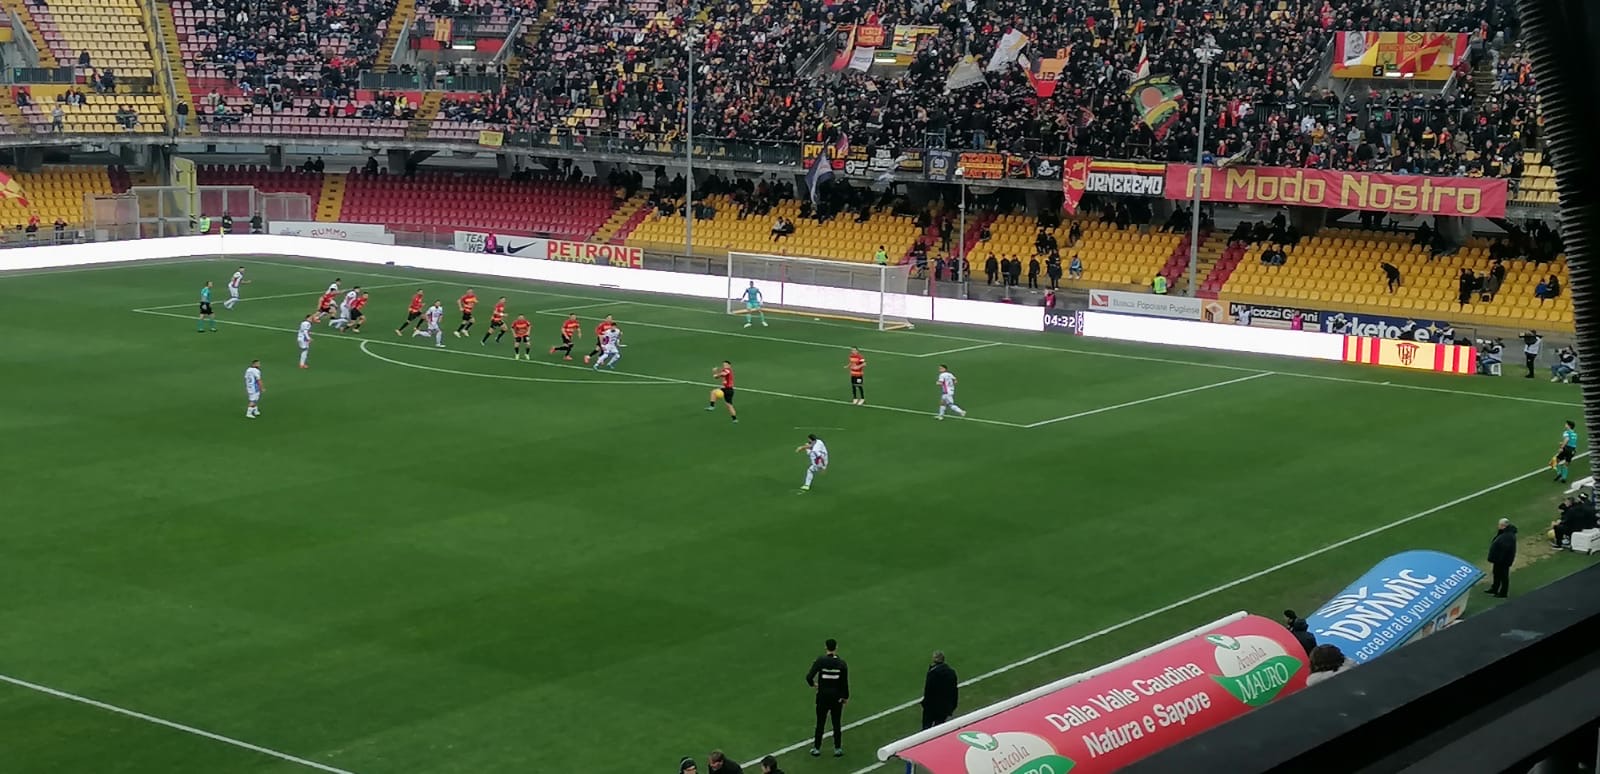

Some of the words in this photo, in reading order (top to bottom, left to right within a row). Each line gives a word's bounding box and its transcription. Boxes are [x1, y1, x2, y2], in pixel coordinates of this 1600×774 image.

[1374, 67, 1382, 76] 5
[1085, 173, 1163, 195] ORNEREMO
[1186, 168, 1211, 198] A
[1225, 169, 1326, 204] Modo
[1341, 174, 1482, 214] Nostro
[311, 228, 347, 238] RUMMO
[466, 233, 483, 243] TEA
[547, 240, 642, 269] PETRONE
[1044, 314, 1075, 328] 04:32
[1282, 309, 1318, 323] Ginni
[1355, 615, 1413, 660] accelerate
[1407, 599, 1435, 620] your
[1430, 564, 1473, 600] advance
[1235, 662, 1289, 704] MAURO
[1045, 704, 1101, 733] Dalla
[1087, 688, 1140, 713] Valle
[1132, 662, 1205, 696] Caudina
[1082, 720, 1144, 758] Natura
[1142, 715, 1156, 733] e
[1152, 691, 1212, 726] Sapore
